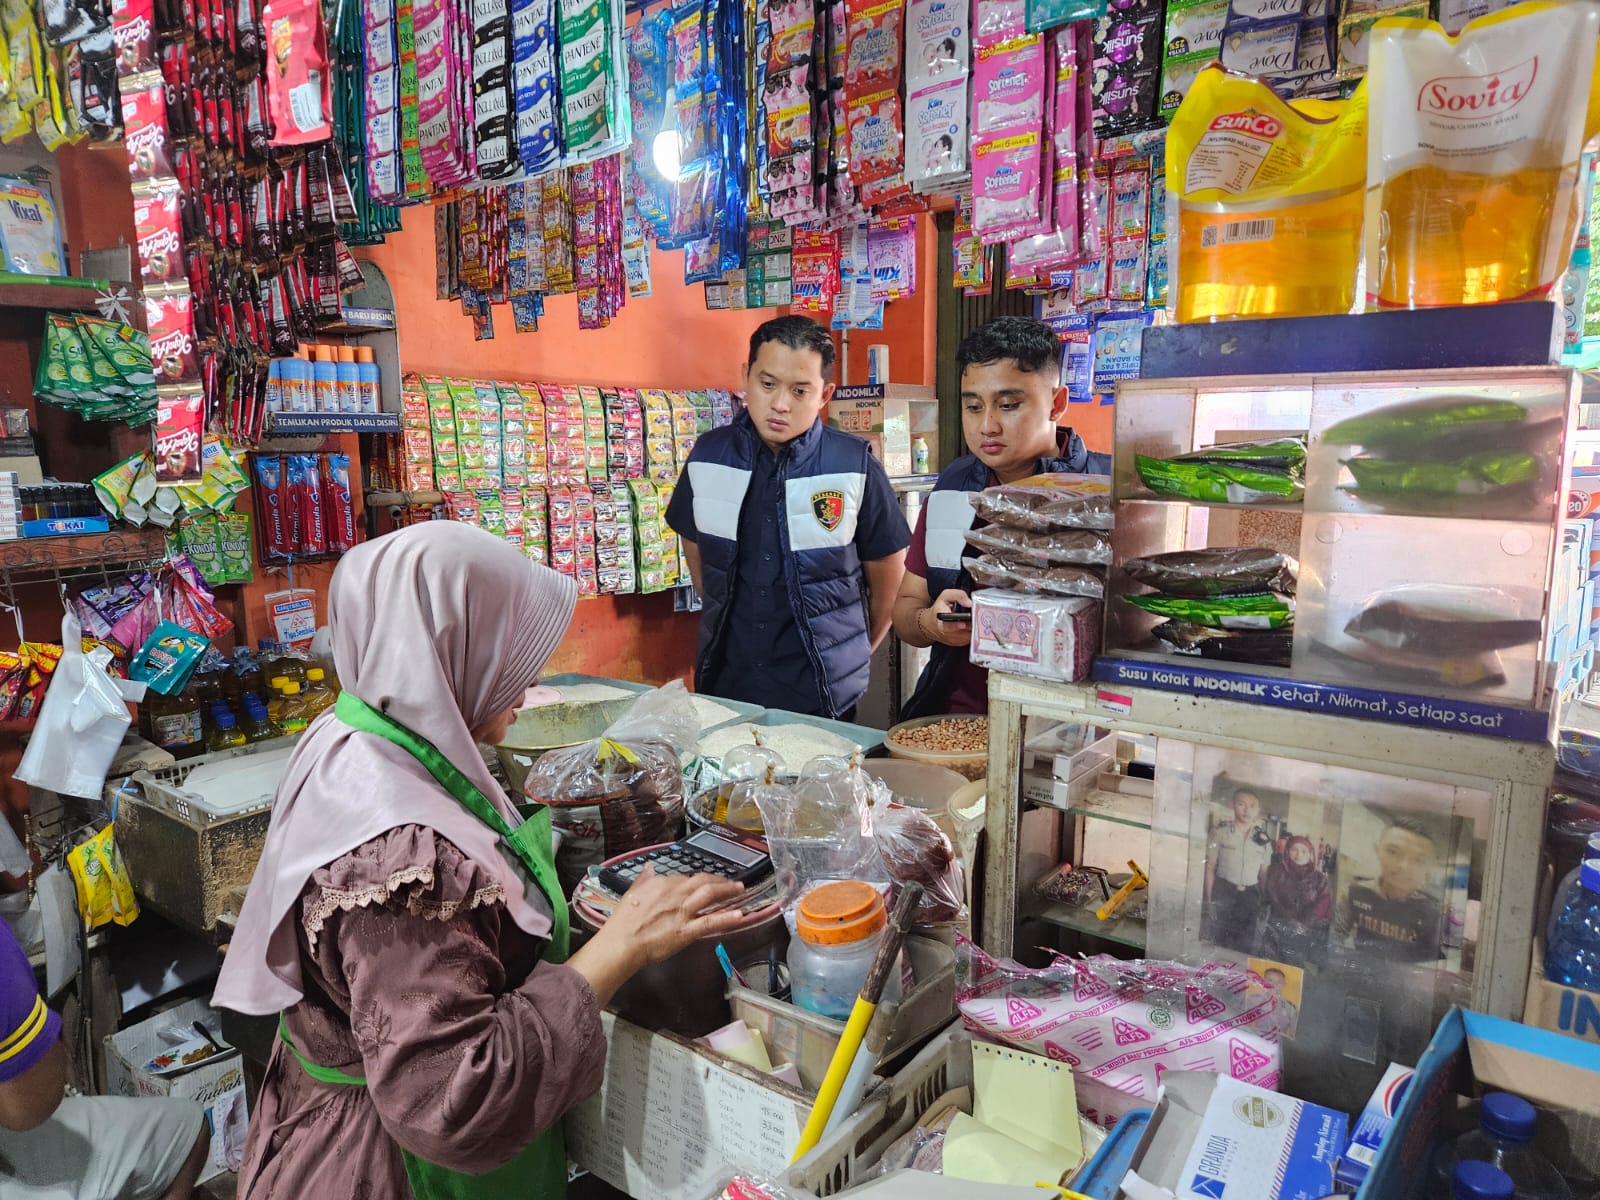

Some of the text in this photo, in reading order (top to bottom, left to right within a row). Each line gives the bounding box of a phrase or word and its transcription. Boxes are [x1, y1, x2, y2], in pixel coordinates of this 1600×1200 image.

[564, 35, 602, 65] PANTENE
[1102, 32, 1144, 54] sunsilk
[1169, 39, 1185, 50] 25%
[1249, 52, 1292, 69] Dove
[567, 88, 603, 116] PANTENE
[1099, 85, 1140, 105] sunsilk
[1164, 94, 1180, 104] 25%
[1428, 76, 1525, 112] Sovia
[984, 171, 1024, 190] Softener
[1118, 190, 1141, 202] Klin
[8, 199, 43, 222] Vixal
[769, 233, 786, 244] ZINC
[1115, 256, 1138, 269] Klin
[873, 265, 901, 281] Klin
[795, 283, 822, 297] Klin
[349, 311, 370, 320] BARU
[836, 387, 880, 398] INDOMILK
[855, 401, 882, 409] INDOMILK
[278, 418, 399, 427] TEMUKAN PRODUK BARU DISINI
[272, 508, 284, 545] Formula
[312, 506, 323, 543] Formula
[344, 505, 354, 541] Formula
[1118, 667, 1504, 727] Susu Kotak INDOMILK Sehat, Nikmat, Setiap saat
[1079, 982, 1107, 999] ALFA
[1012, 1008, 1039, 1026] ALFA
[1191, 1003, 1220, 1021] ALFA
[1119, 1032, 1146, 1045] ALFA
[1234, 1056, 1265, 1076] ALFA
[1311, 1114, 1332, 1163] Amplop Airmail
[1198, 1134, 1231, 1176] GRANDIA
